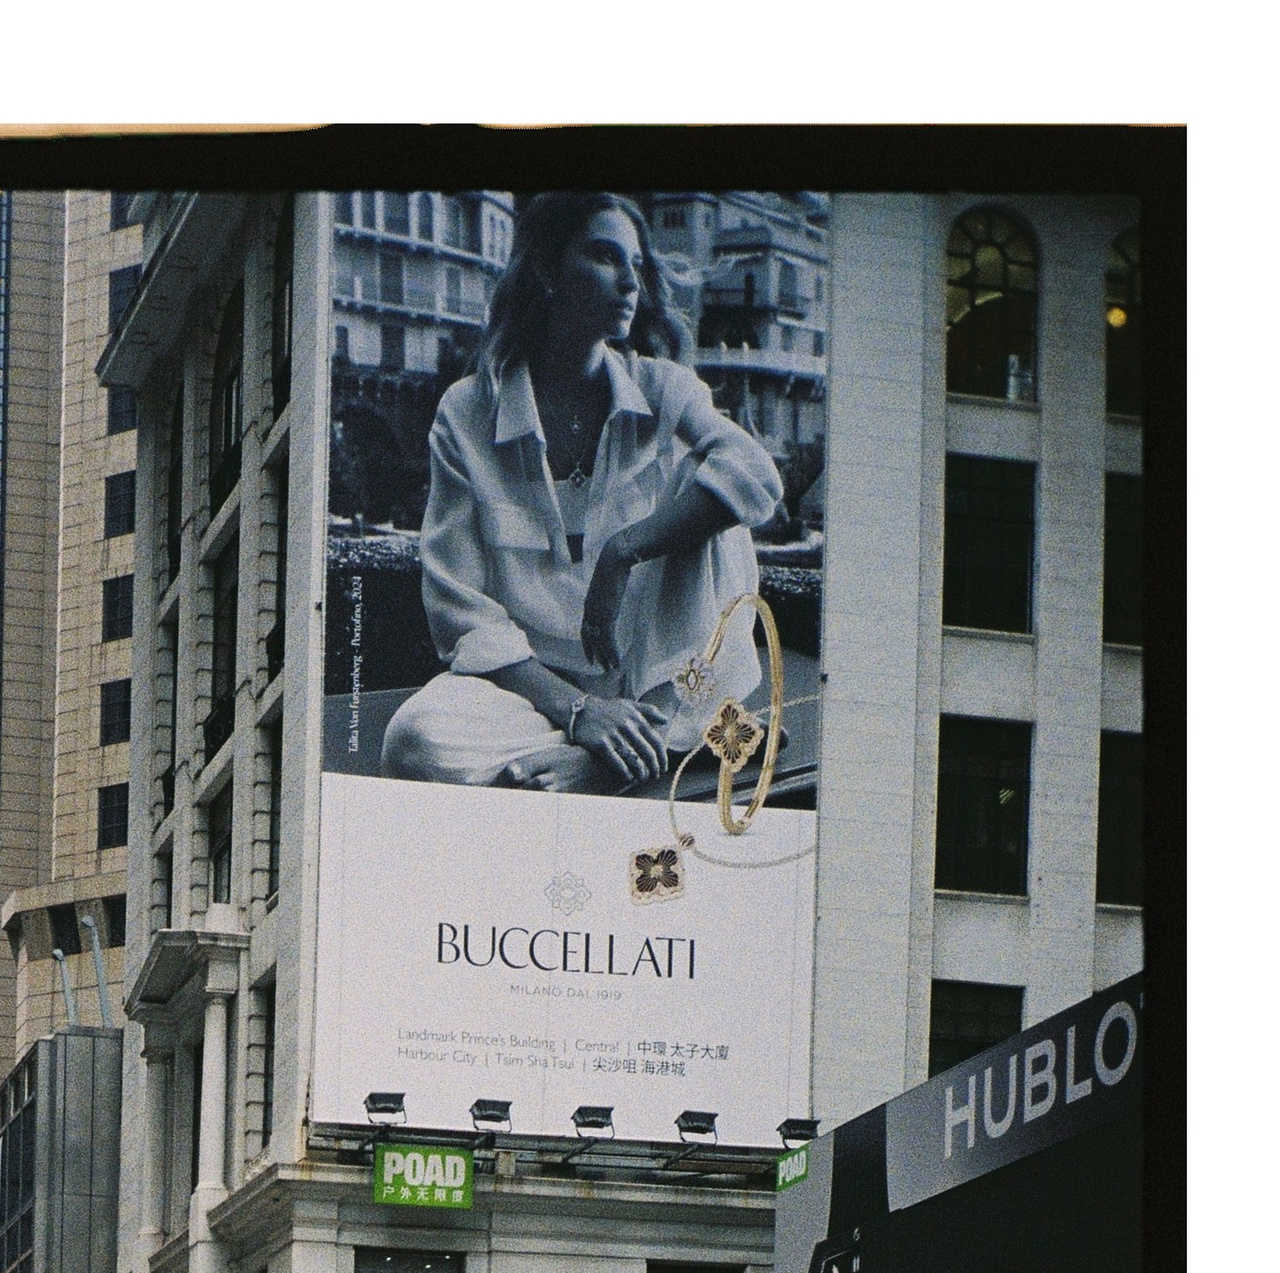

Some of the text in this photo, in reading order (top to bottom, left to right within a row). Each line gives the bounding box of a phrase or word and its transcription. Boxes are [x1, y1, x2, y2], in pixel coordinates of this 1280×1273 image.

[437, 921, 696, 980] BUCCELLATI
[510, 985, 622, 1001] MILANO DAL 1919
[398, 1027, 456, 1043] Landmark
[461, 1031, 506, 1047] Prince's
[510, 1034, 555, 1051] Building
[575, 1038, 620, 1053] Central
[637, 1040, 667, 1056] 中環
[398, 1047, 686, 1077] Harbour City Tsim Sha Tsui 尖沙咀 海港城
[944, 993, 1144, 1161] HUBLO
[384, 1152, 466, 1187] POAD
[777, 1152, 806, 1186] POAD
